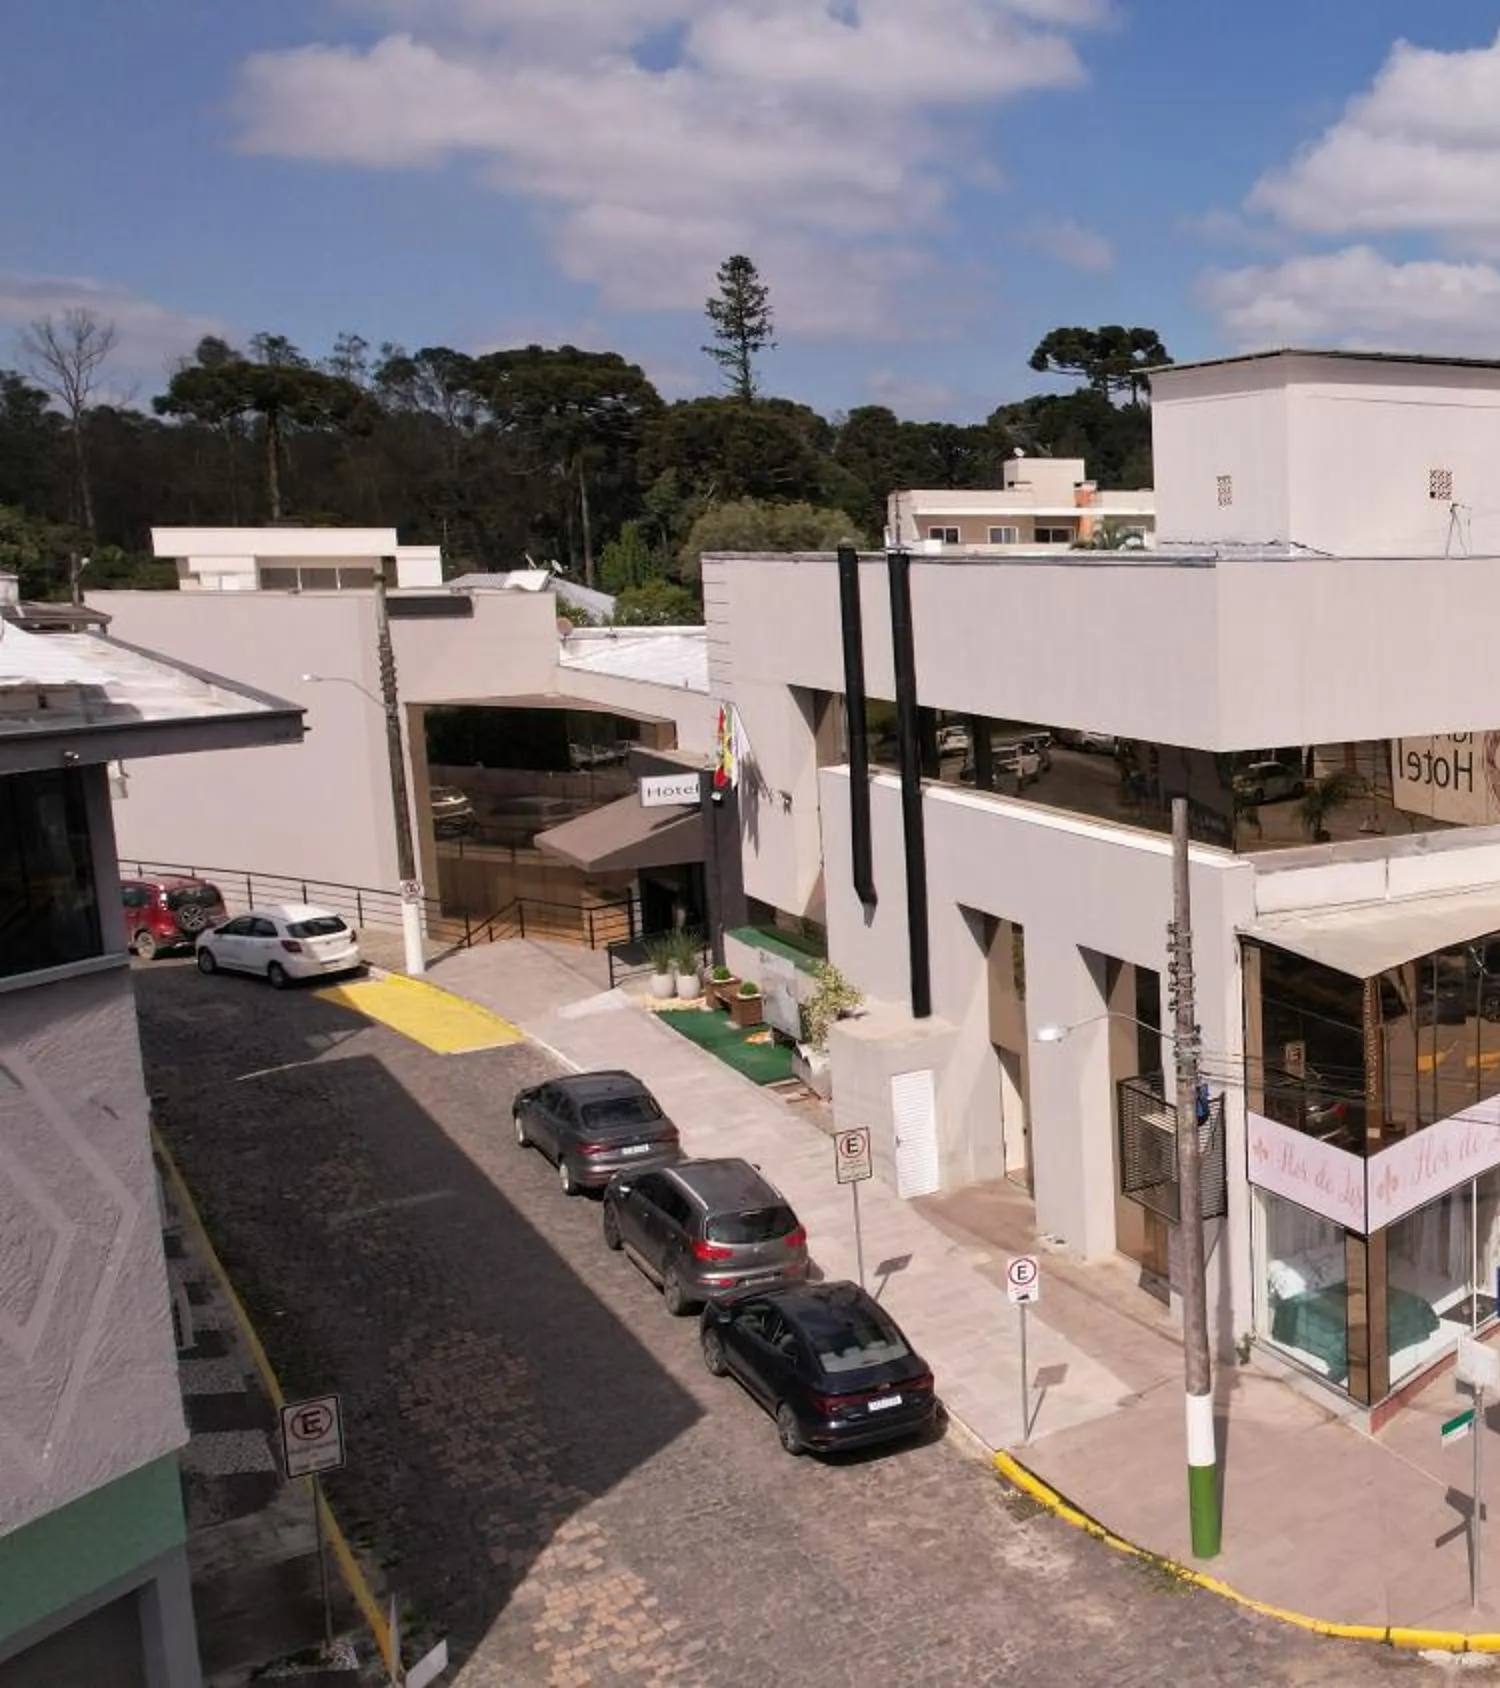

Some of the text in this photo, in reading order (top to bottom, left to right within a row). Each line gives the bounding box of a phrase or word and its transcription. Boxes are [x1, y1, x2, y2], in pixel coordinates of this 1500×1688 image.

[647, 783, 699, 798] Hotel
[846, 1137, 859, 1154] E
[1017, 1265, 1028, 1280] E
[301, 1409, 322, 1435] E
